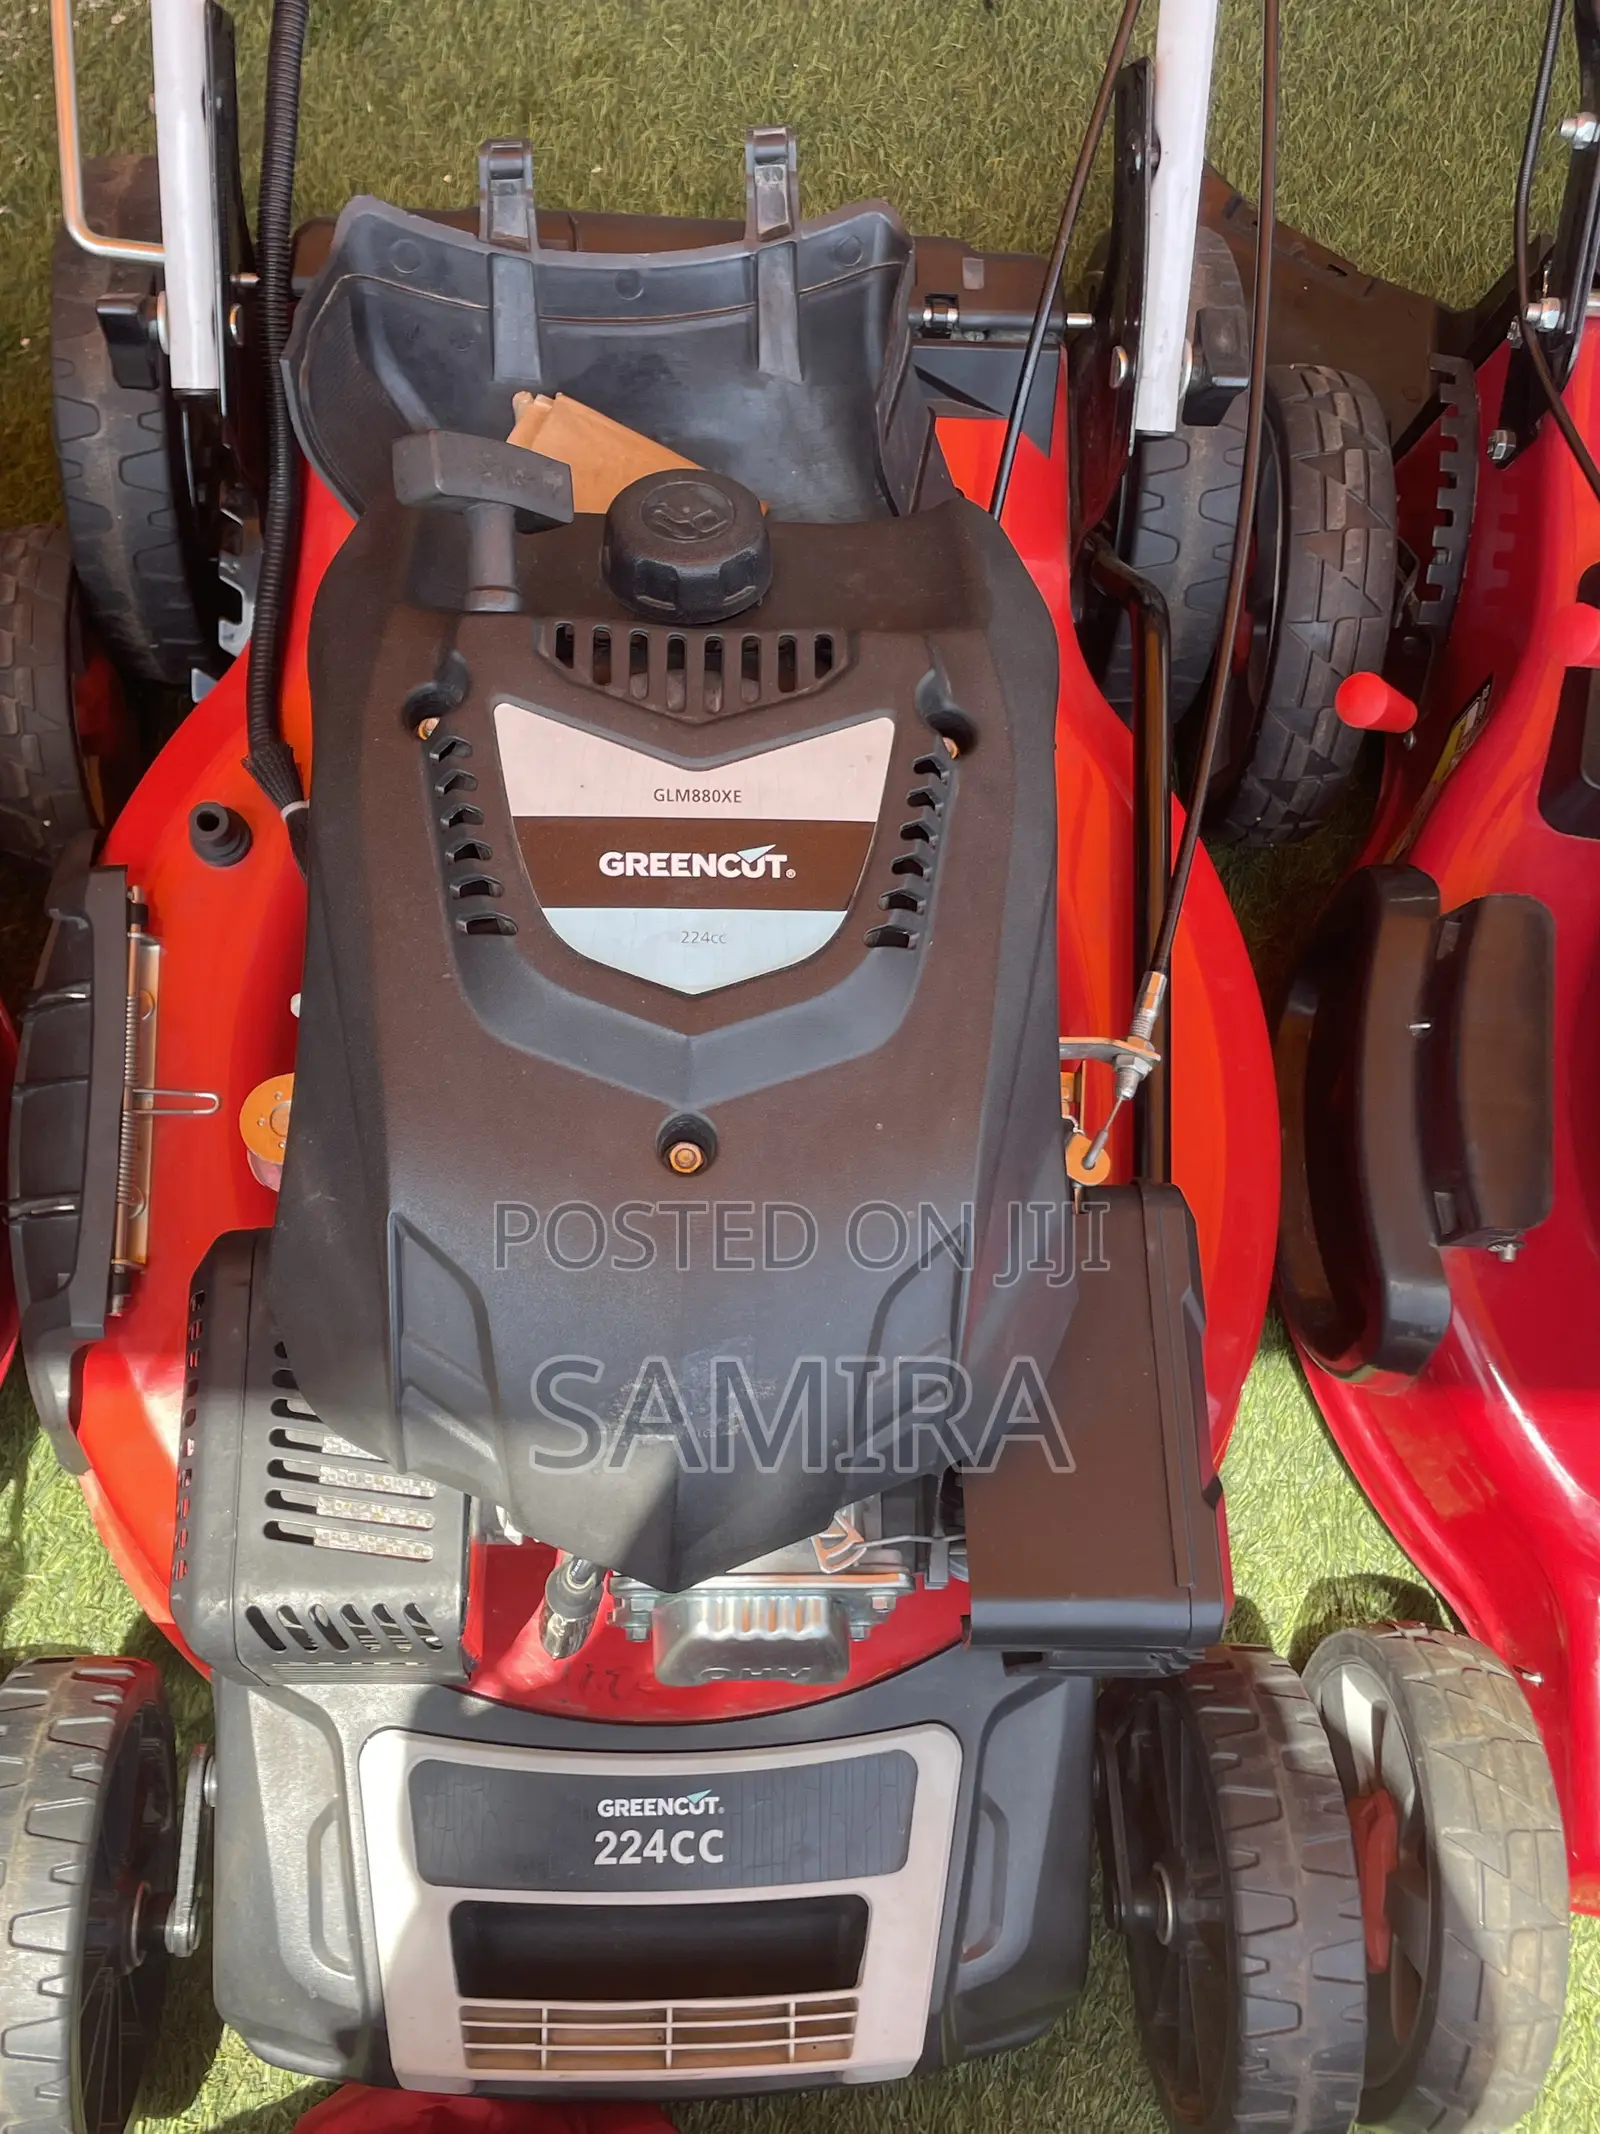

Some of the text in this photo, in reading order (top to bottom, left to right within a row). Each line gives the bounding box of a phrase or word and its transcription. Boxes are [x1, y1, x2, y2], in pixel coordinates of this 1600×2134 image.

[653, 788, 742, 803] GLM880XE
[681, 930, 727, 945] 224cc
[594, 1829, 724, 1865] 224CC
